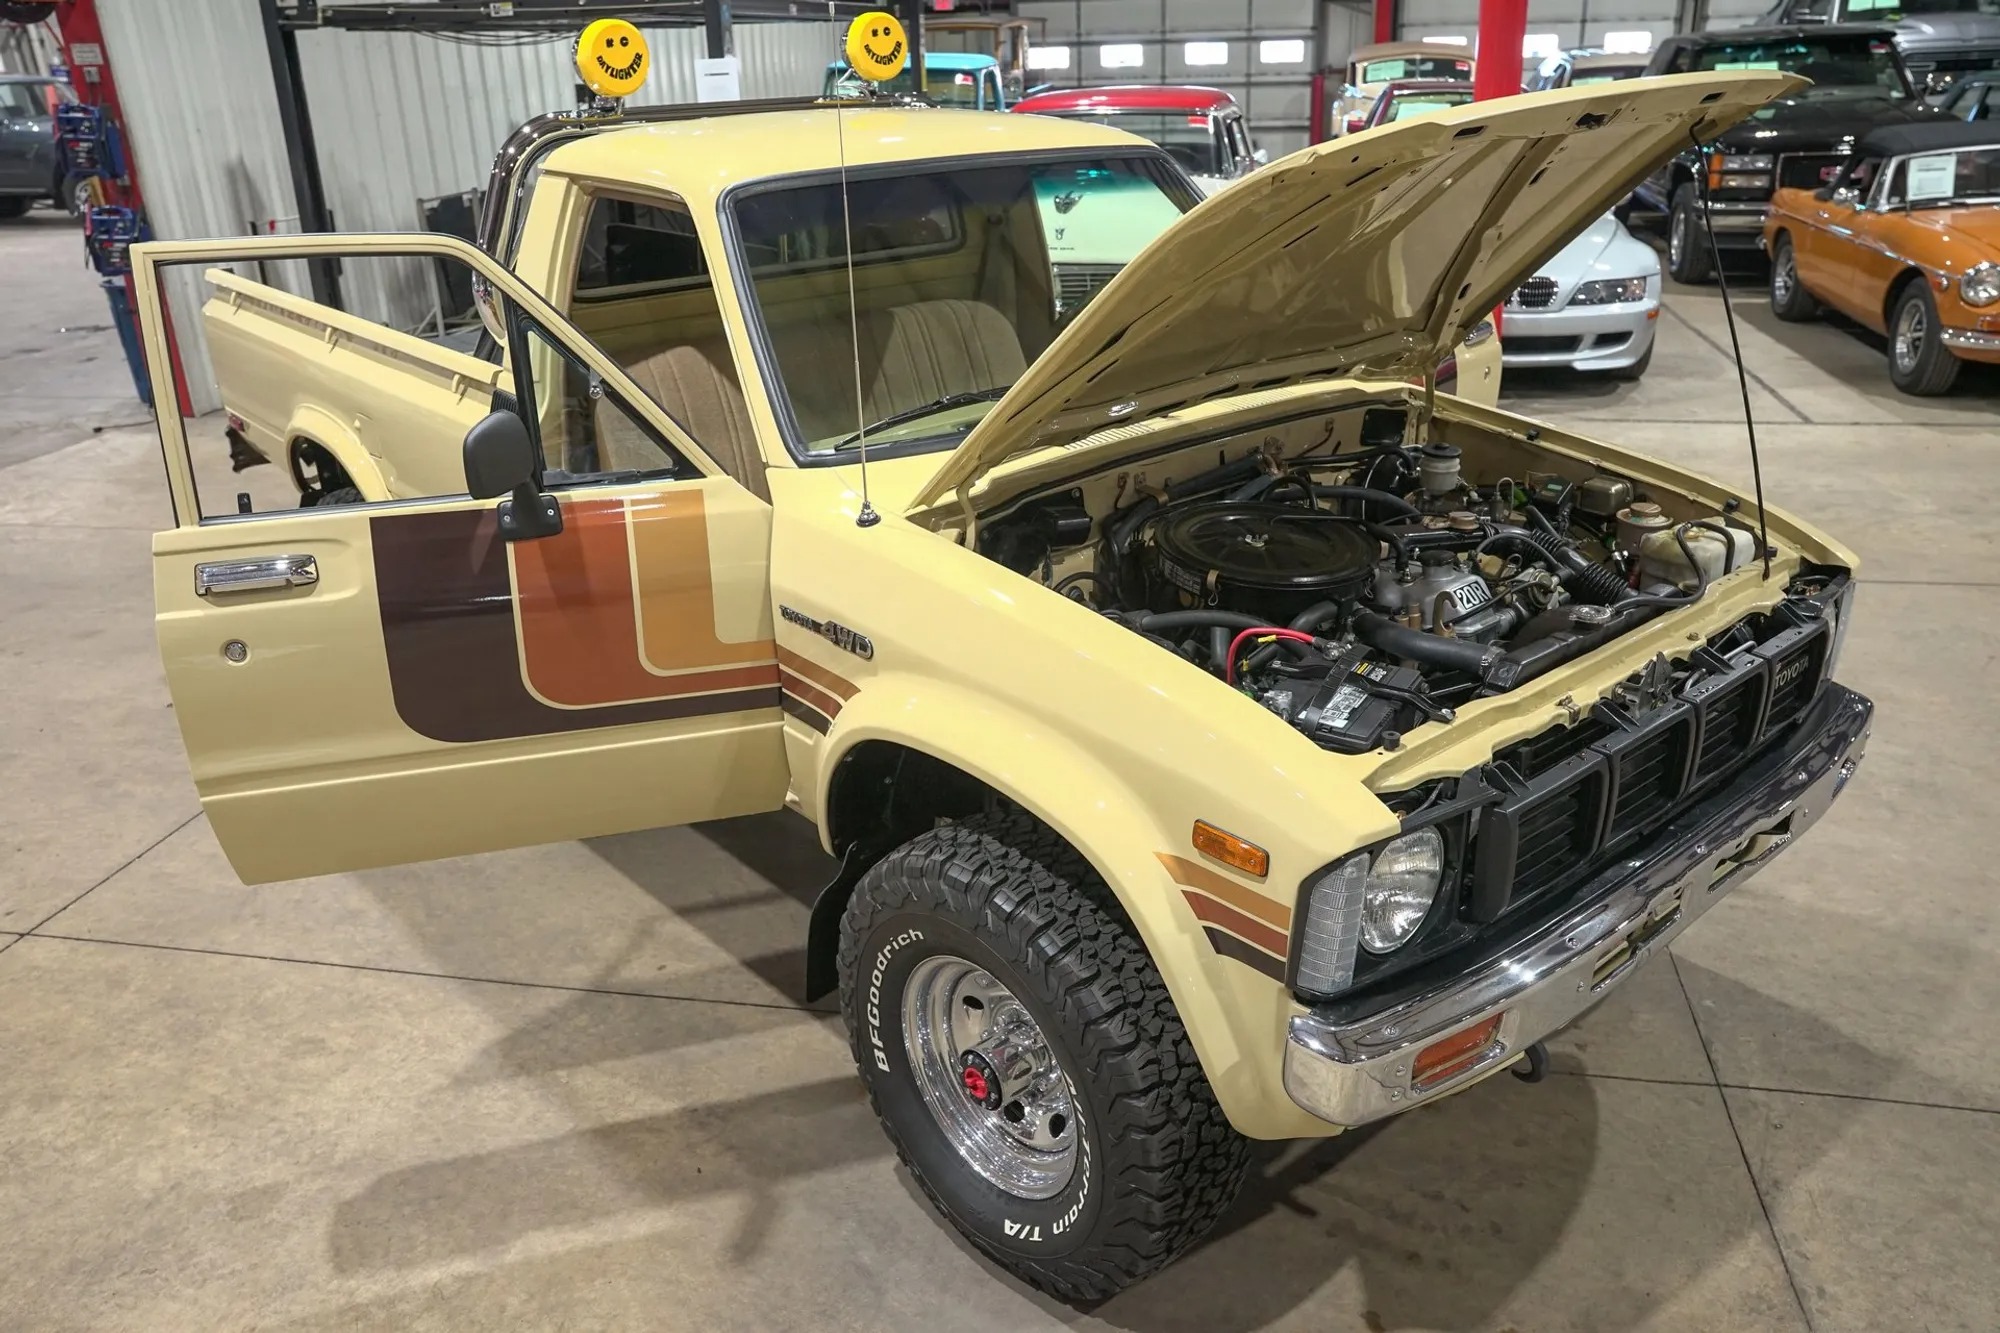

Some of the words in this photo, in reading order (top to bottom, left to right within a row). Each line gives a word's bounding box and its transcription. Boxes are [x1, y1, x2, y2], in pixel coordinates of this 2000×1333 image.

[596, 52, 644, 80] DAYLIGHTER
[1456, 583, 1489, 609] 20R
[820, 620, 874, 661] 4WD
[1775, 655, 1809, 690] TOYOTA
[867, 928, 925, 1073] BFGoodrich
[1003, 1218, 1043, 1242] T/A
